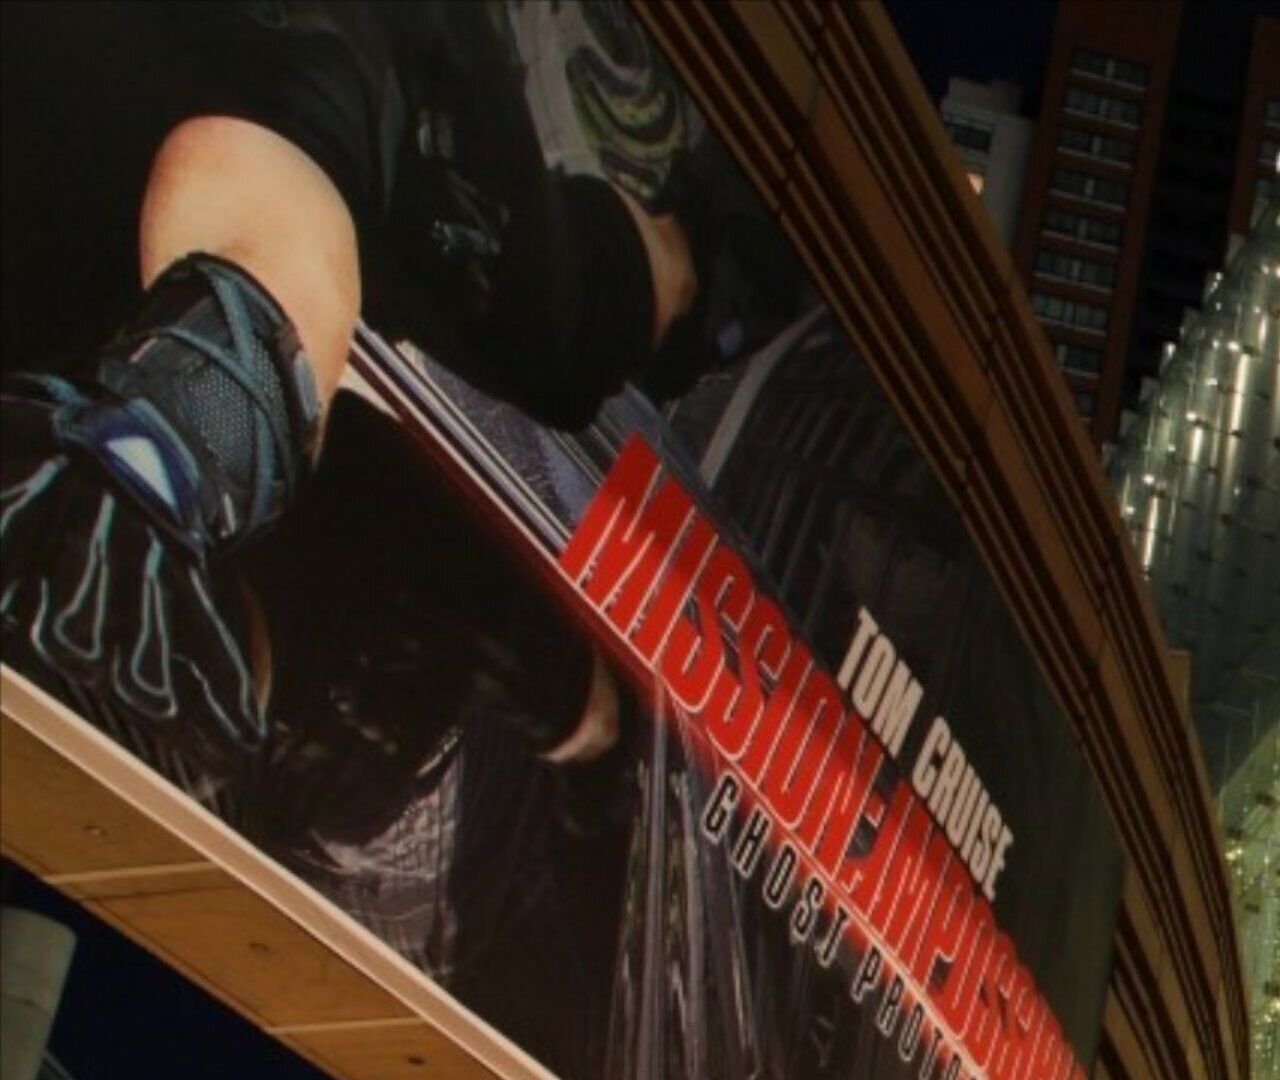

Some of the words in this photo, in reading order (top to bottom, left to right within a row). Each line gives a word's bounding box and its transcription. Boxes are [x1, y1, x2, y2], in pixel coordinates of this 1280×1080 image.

[702, 775, 850, 968] GHOST
[838, 607, 923, 762] TOM
[912, 717, 1014, 900] CRUISE
